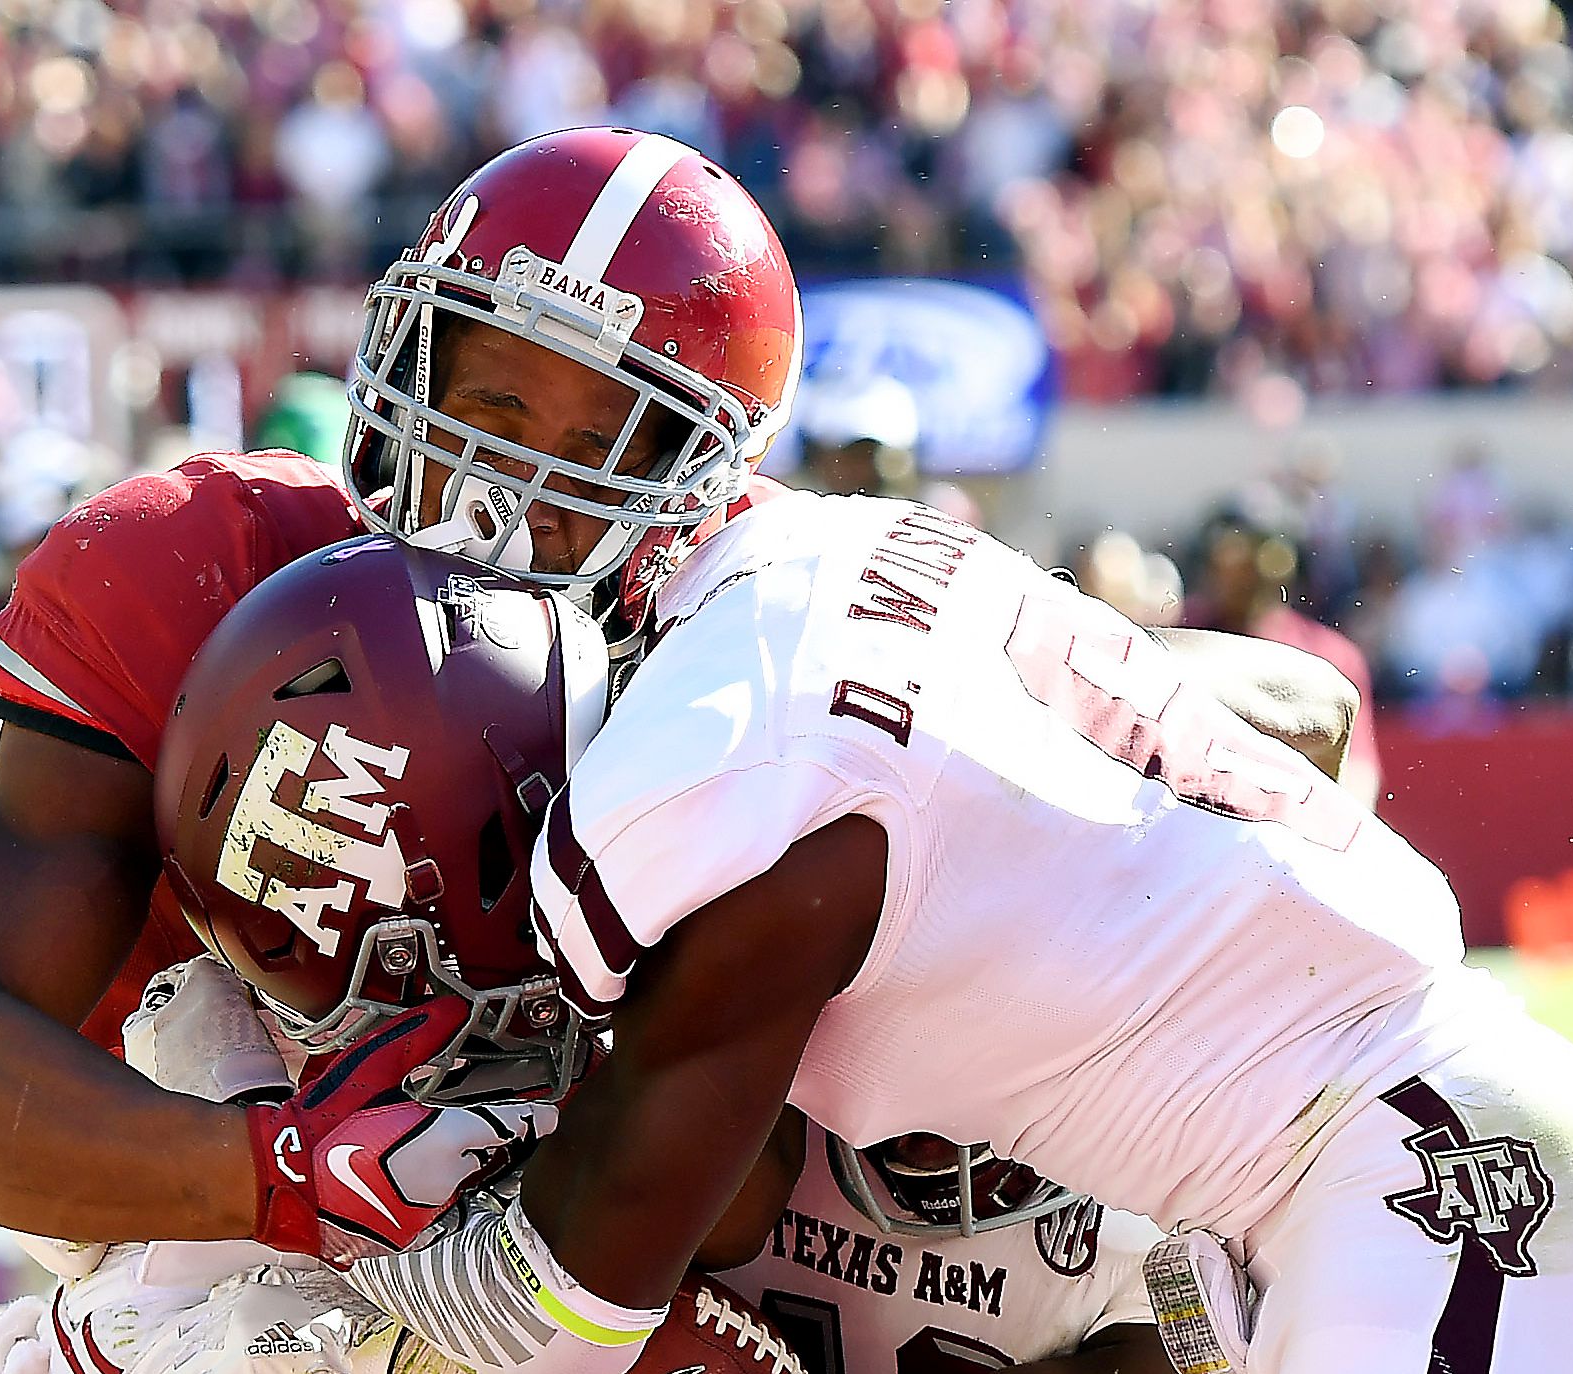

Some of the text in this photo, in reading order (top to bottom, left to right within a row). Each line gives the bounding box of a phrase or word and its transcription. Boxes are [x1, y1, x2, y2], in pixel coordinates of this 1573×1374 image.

[539, 266, 605, 311] BAMA
[846, 504, 977, 634] WILSO
[828, 679, 921, 748] D.
[499, 1218, 542, 1294] SPEED
[771, 1207, 1008, 1318] TEXAS A&M
[247, 1339, 315, 1356] adidas
